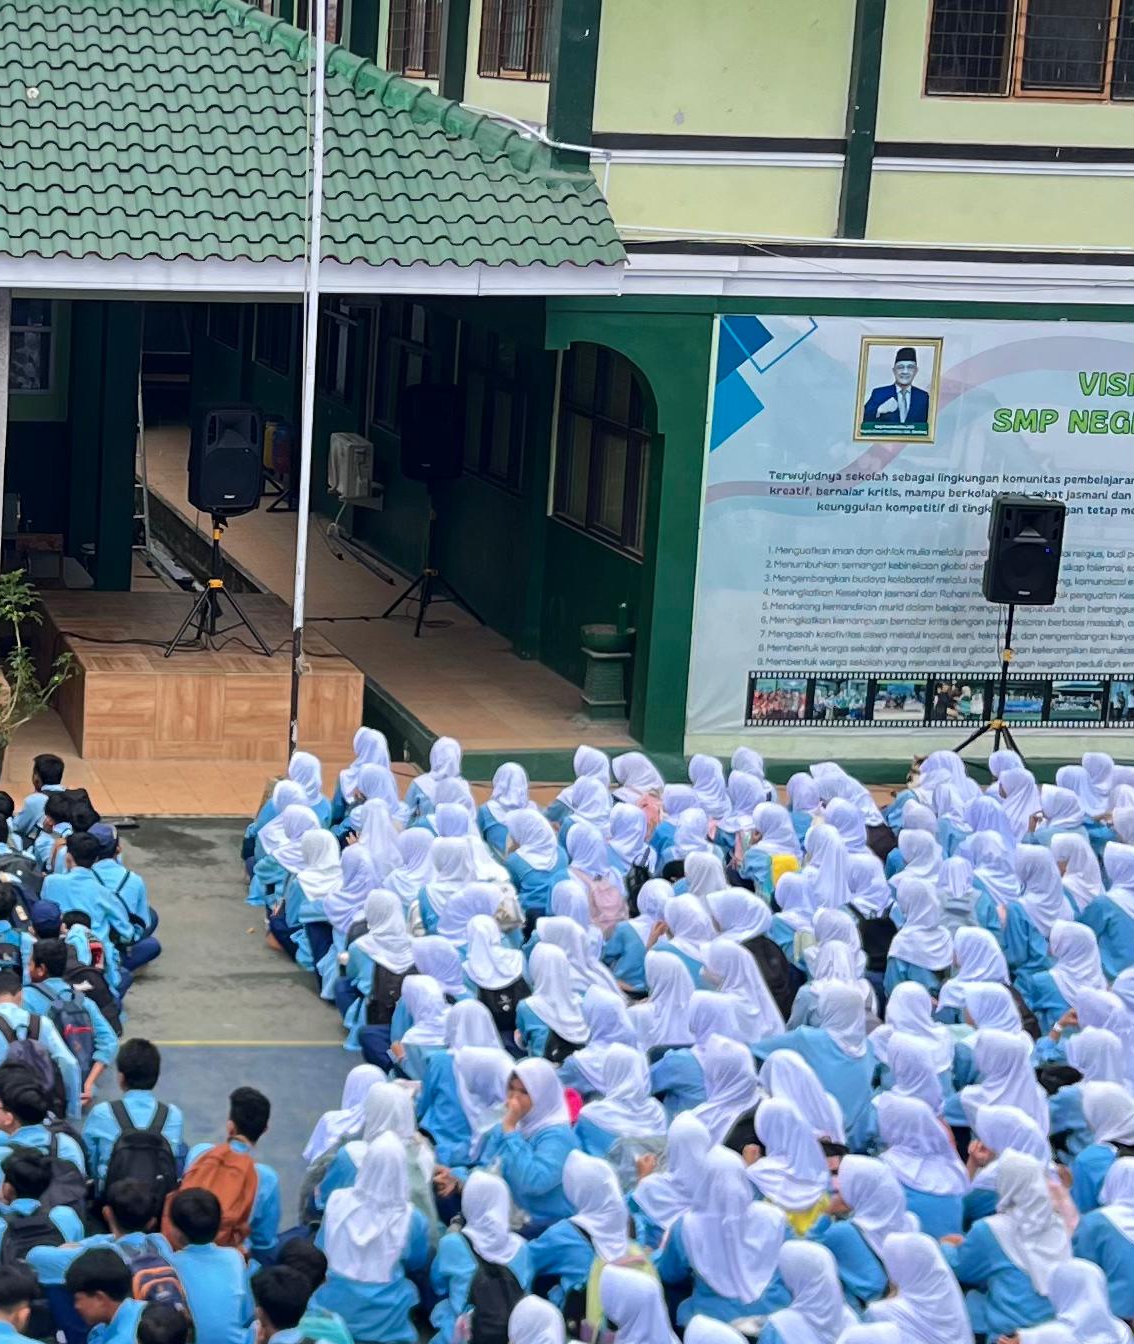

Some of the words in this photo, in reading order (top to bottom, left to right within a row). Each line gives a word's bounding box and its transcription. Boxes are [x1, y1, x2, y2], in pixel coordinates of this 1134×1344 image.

[992, 408, 1059, 433] SMP
[1068, 410, 1134, 435] NEG
[769, 470, 842, 483] Terwujudnya
[845, 472, 888, 482] sekolah
[892, 472, 935, 485] sebagai
[937, 473, 999, 485] lingkungan
[1002, 474, 1061, 484] komunitas
[769, 486, 812, 497] kreatif,
[816, 487, 865, 496] bernalar
[867, 487, 902, 498] kritis,
[904, 490, 945, 499] mampu
[1065, 489, 1108, 501] jasmani
[1111, 491, 1131, 500] dan
[816, 502, 883, 514] keunggulan
[885, 503, 945, 515] kompetitif
[949, 503, 958, 513] di
[1087, 506, 1117, 516] tetap
[856, 547, 874, 555] dan
